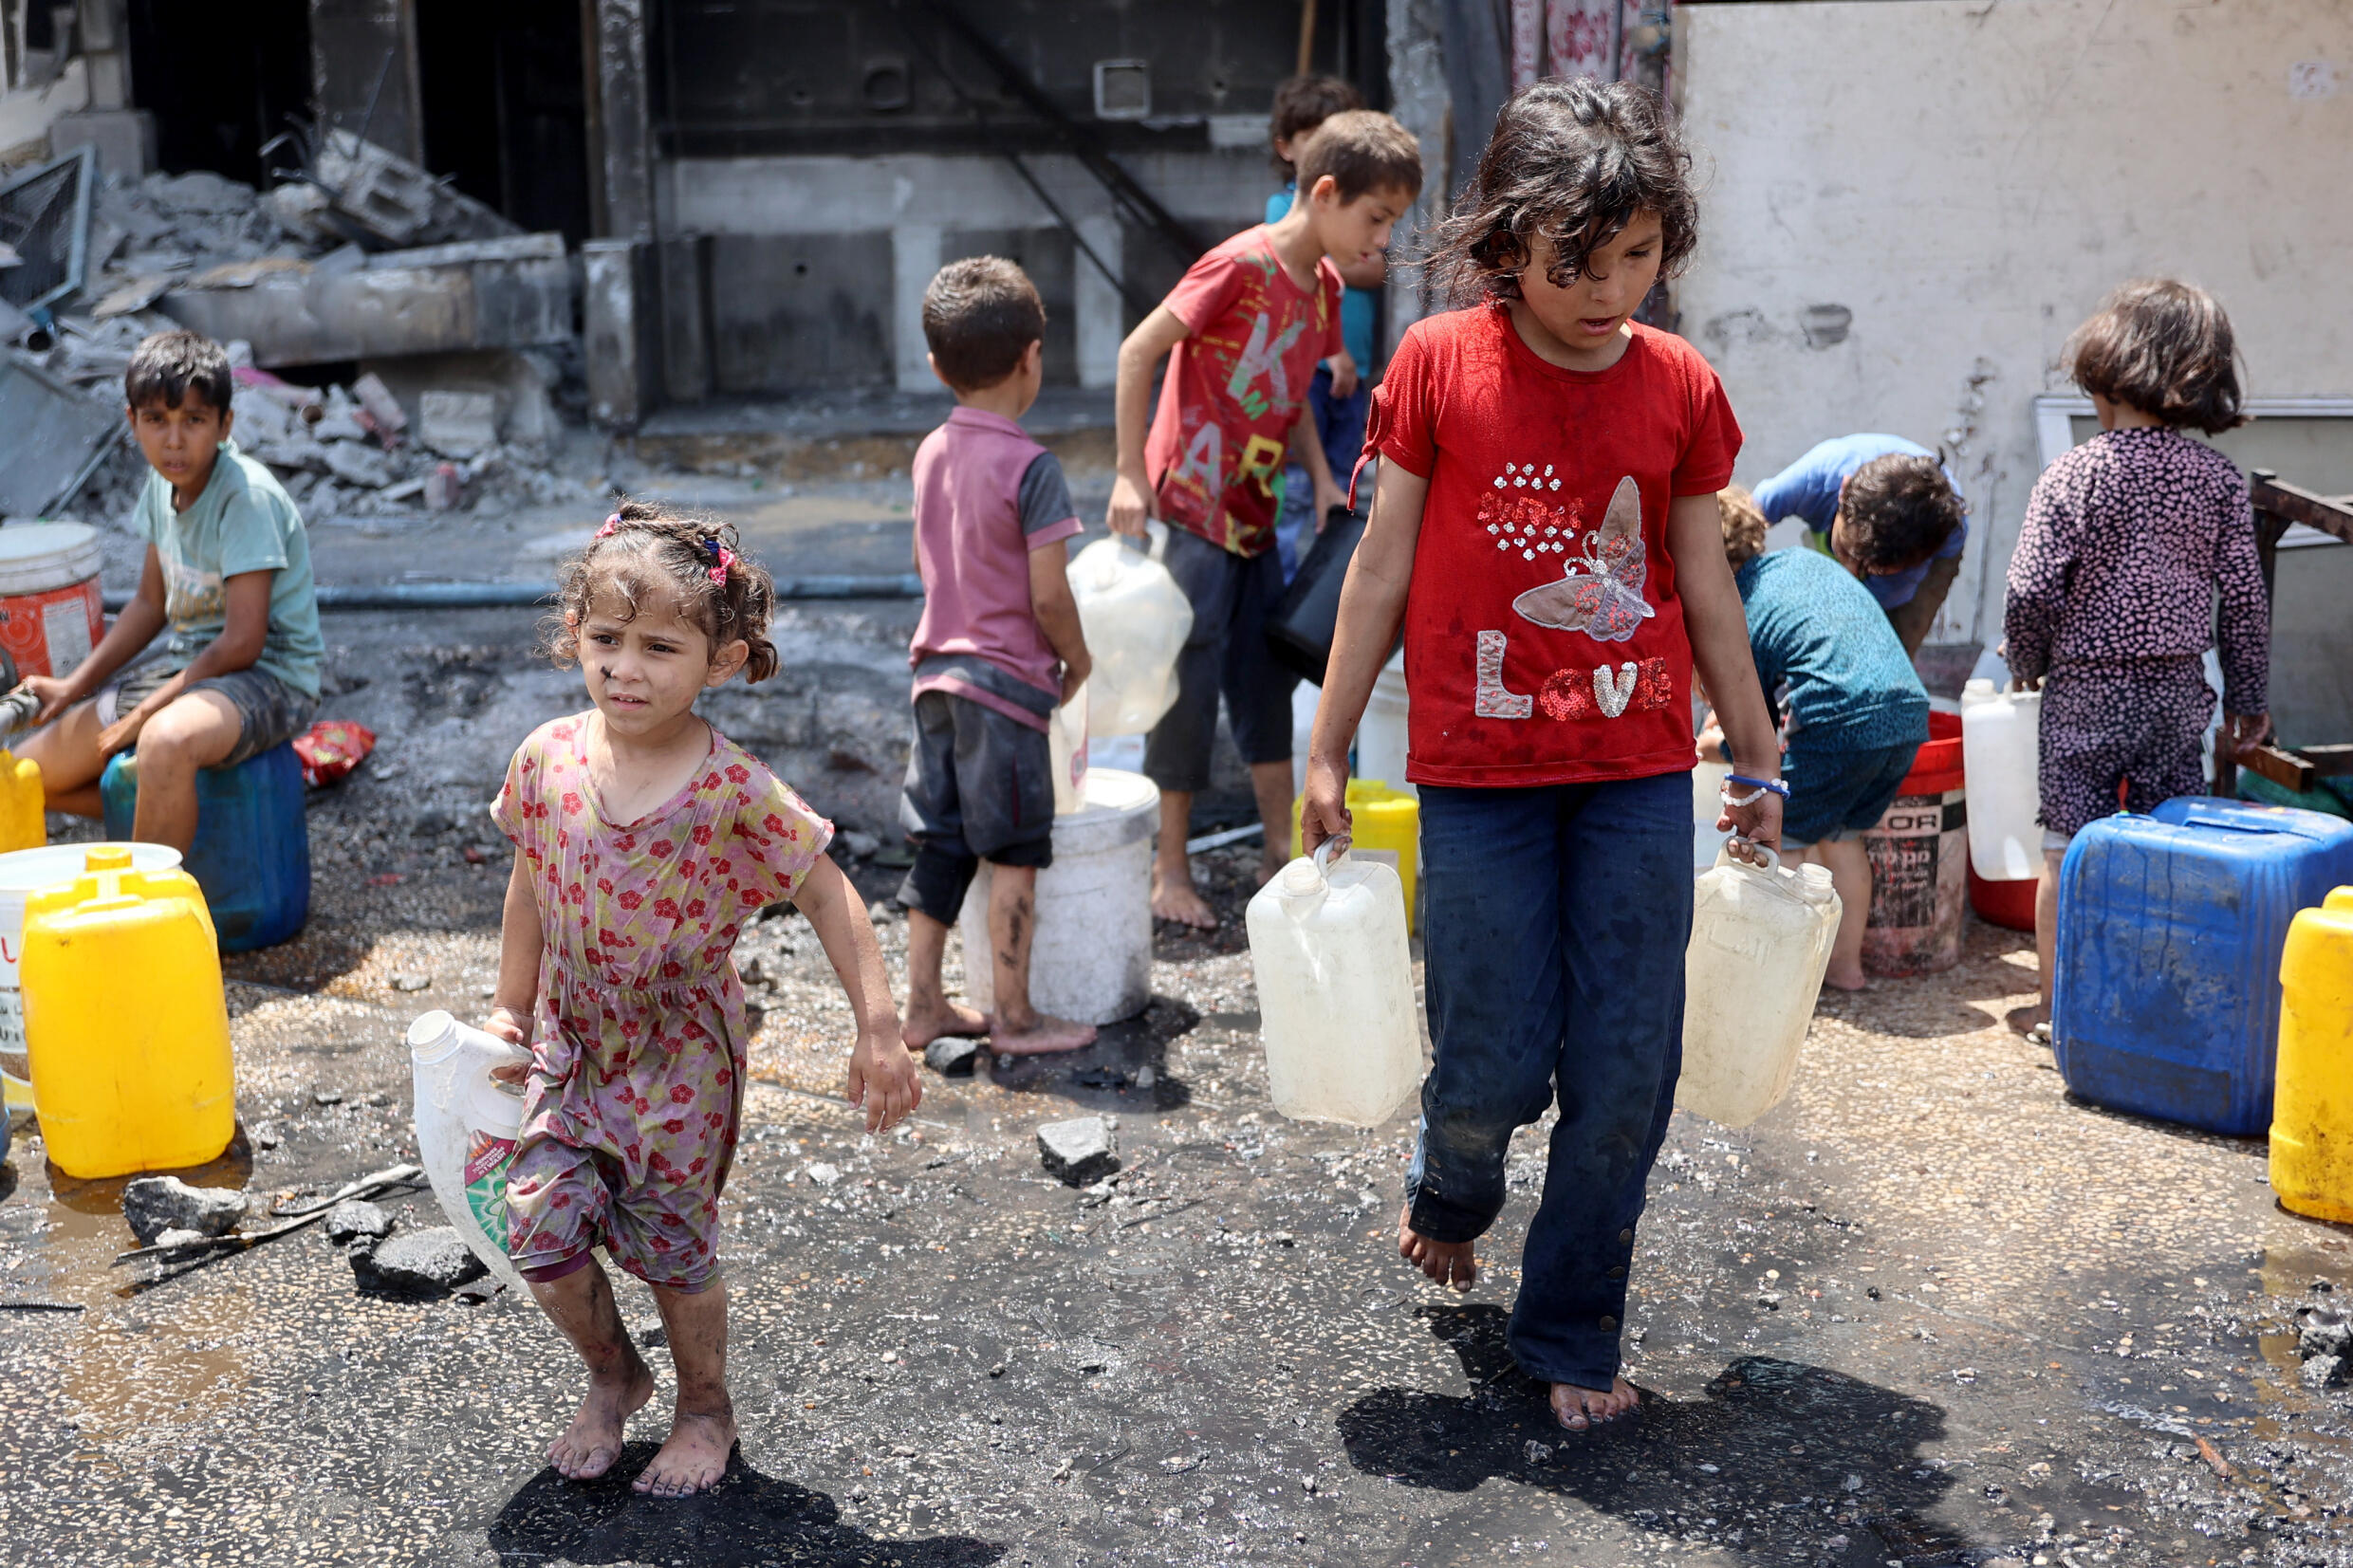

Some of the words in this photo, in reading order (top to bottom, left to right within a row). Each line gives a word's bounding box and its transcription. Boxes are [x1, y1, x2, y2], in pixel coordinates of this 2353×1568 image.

[1475, 629, 1673, 721] LOVE
[468, 1137, 493, 1159] NEW
[474, 1146, 498, 1166] REMOVES
[486, 1151, 506, 1168] WASH
